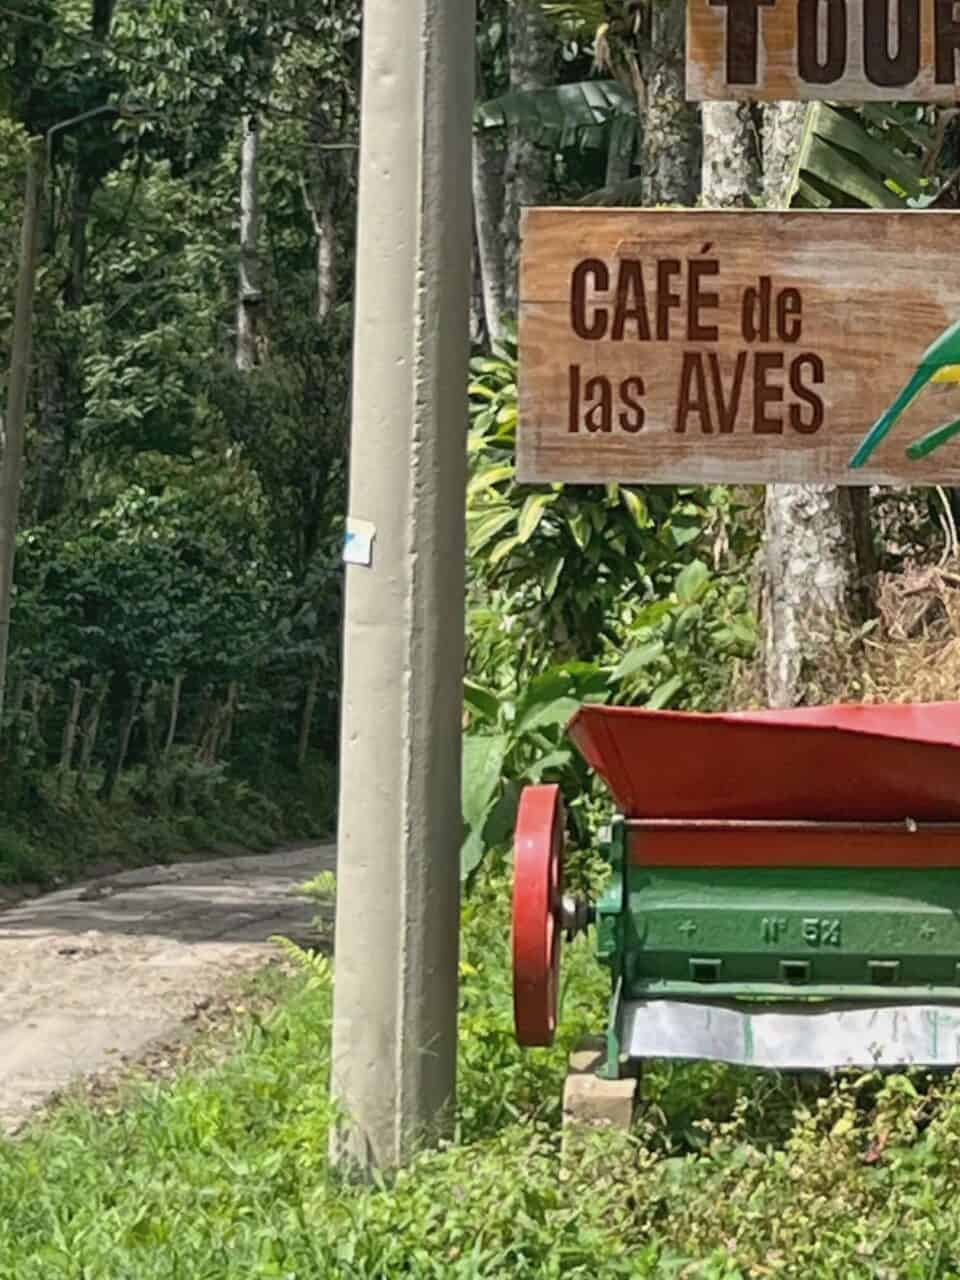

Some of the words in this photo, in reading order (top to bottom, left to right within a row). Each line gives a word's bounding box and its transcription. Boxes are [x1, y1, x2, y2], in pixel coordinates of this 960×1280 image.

[570, 242, 719, 342] CAFÉ
[741, 275, 802, 344] de
[568, 363, 645, 433] las
[674, 350, 824, 435] AVES
